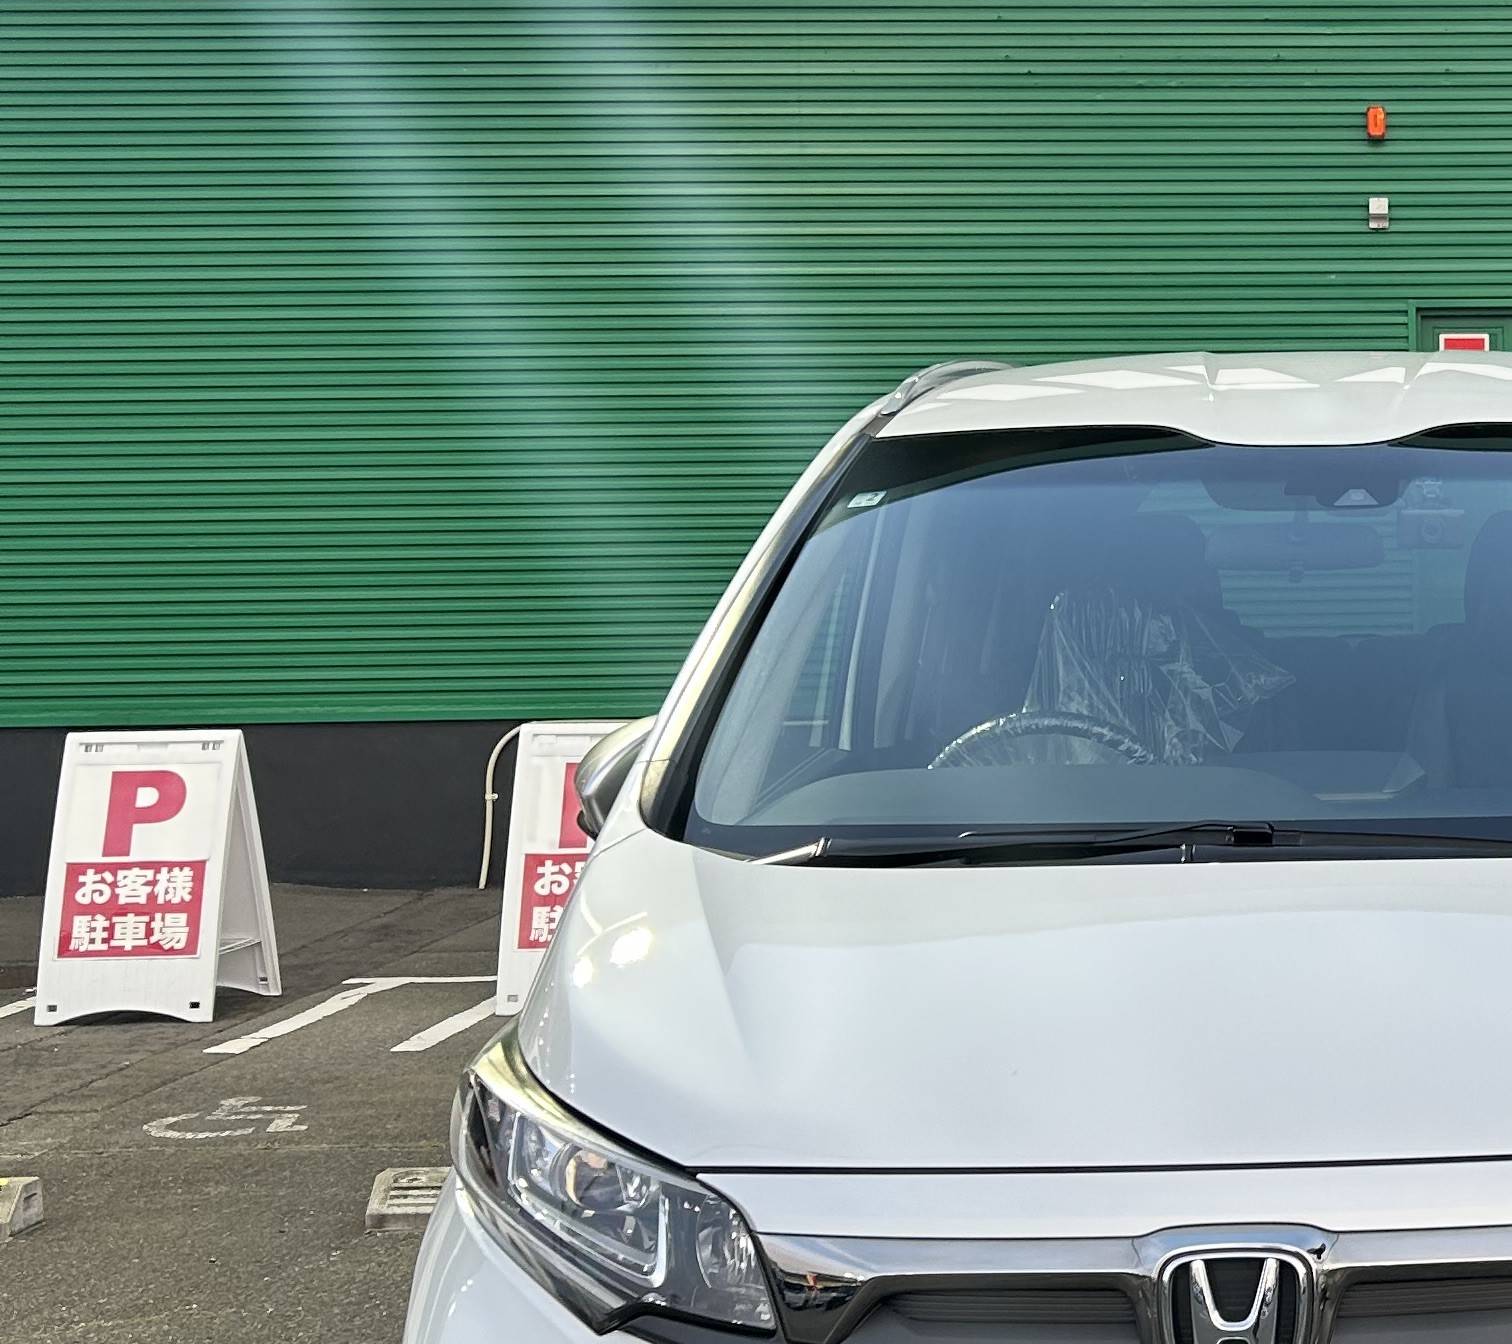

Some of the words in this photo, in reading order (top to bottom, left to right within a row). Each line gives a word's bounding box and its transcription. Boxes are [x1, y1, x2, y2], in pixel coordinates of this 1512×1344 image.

[102, 770, 187, 857] P
[74, 866, 194, 905] お客様
[69, 912, 190, 953] 駐車場
